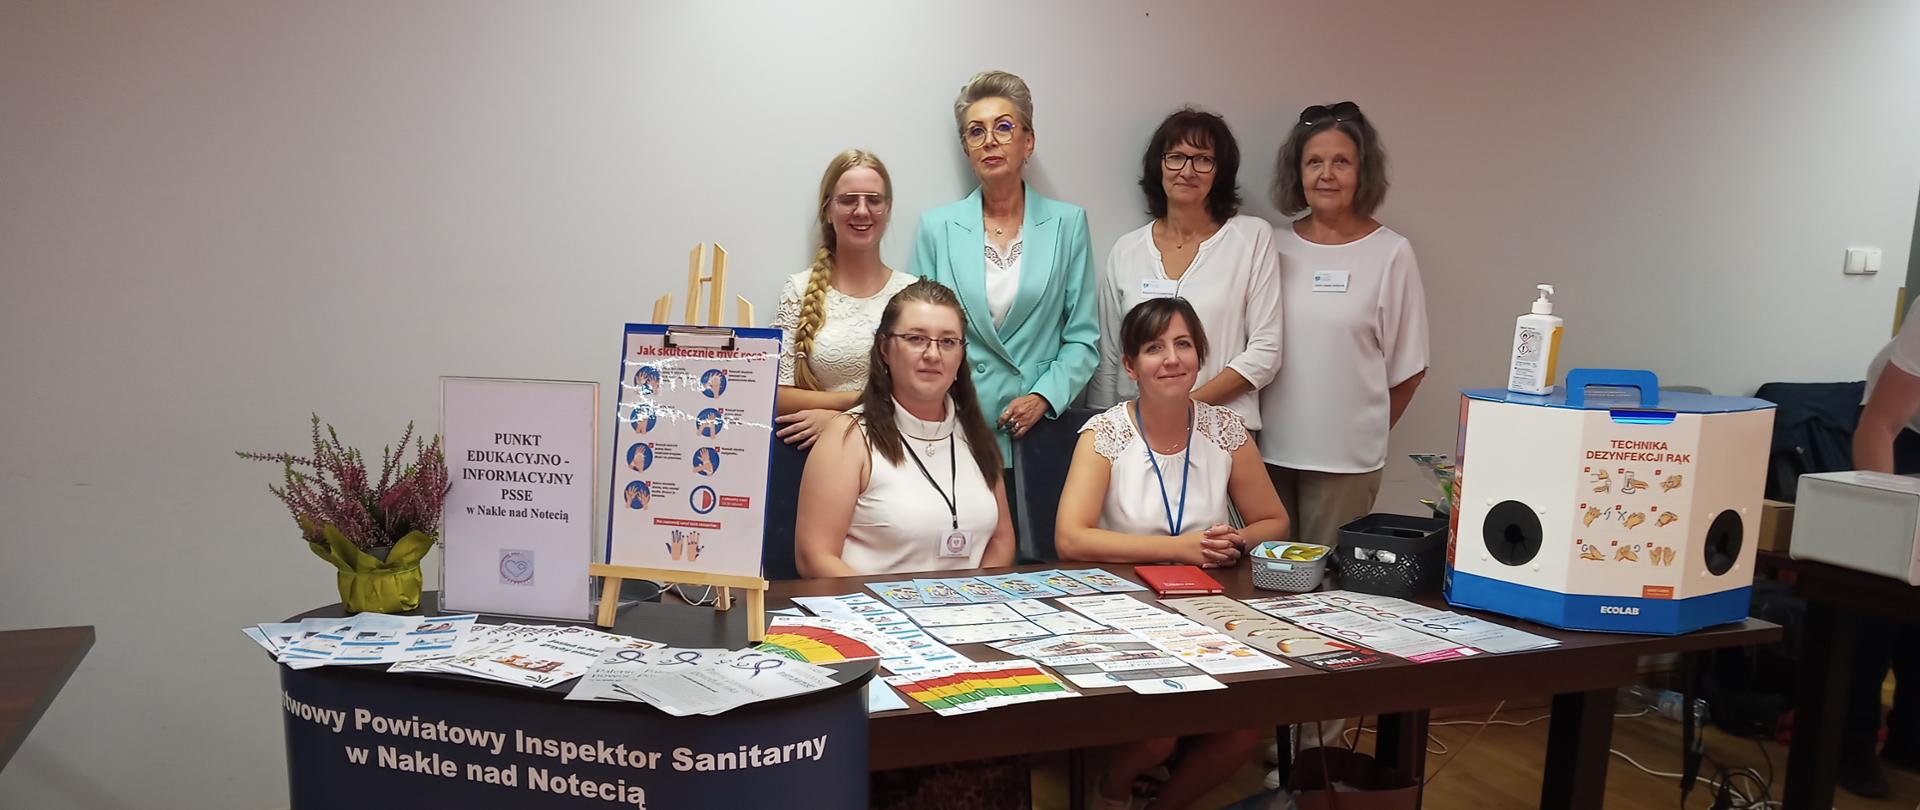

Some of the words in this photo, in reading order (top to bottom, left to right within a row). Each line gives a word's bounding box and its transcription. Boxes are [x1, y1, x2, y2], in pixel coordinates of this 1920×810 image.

[637, 346, 655, 356] Jak
[657, 346, 714, 358] skutecznie
[495, 433, 542, 446] PUNKT
[1610, 440, 1668, 450] TECHNIKA
[467, 450, 562, 466] EDUKACYJNO
[1586, 450, 1663, 462] DEZYNFEKCJI
[1666, 453, 1691, 465] RĄK
[463, 468, 574, 485] INFORMACYJNY
[501, 489, 533, 501] PSSE
[466, 506, 475, 515] w
[477, 505, 507, 517] Nakle
[509, 507, 528, 518] nad
[530, 508, 569, 523] Notecią
[1600, 606, 1640, 616] ECOLAB
[354, 708, 506, 755] Powiatowy
[515, 729, 662, 770] Inspektor
[671, 734, 828, 772] Sanitarny
[345, 745, 369, 765] w
[377, 745, 458, 778] Nakle
[466, 763, 518, 787] nad
[527, 766, 647, 810] Notecią
